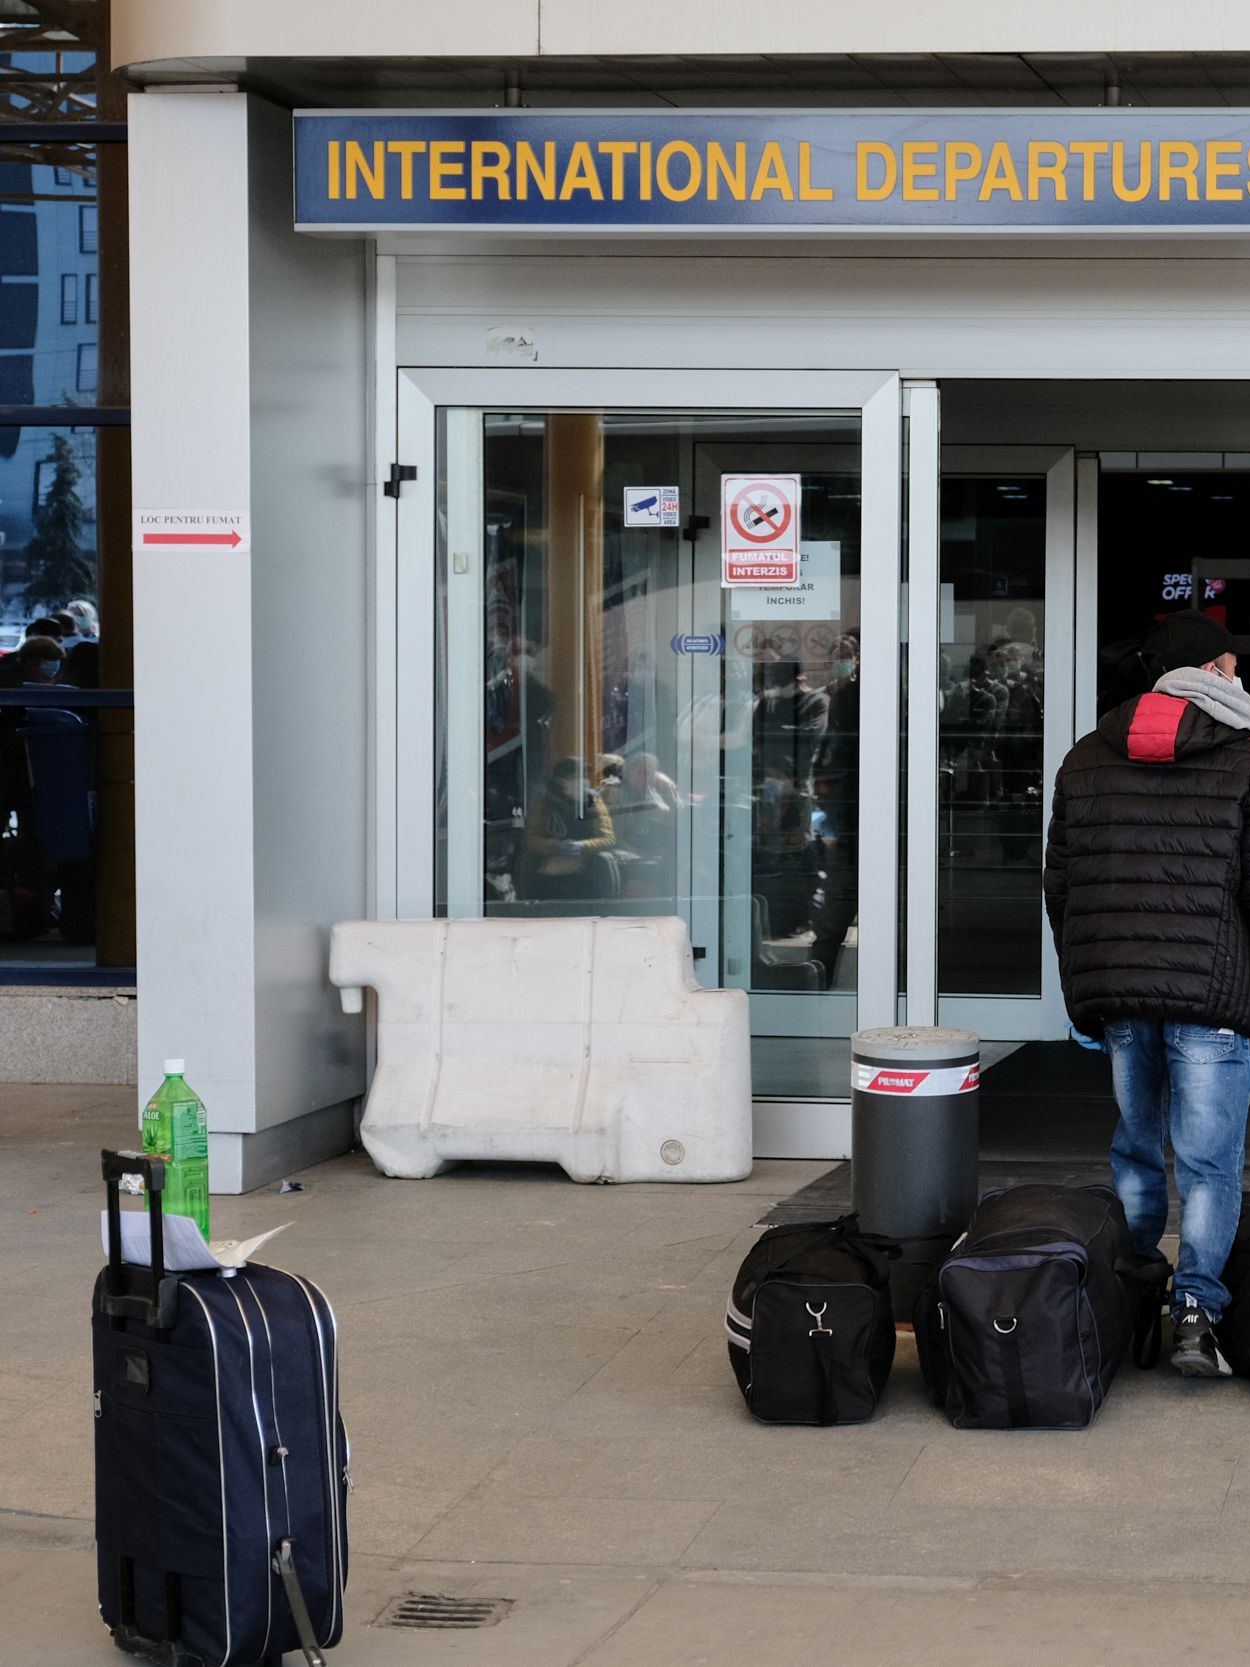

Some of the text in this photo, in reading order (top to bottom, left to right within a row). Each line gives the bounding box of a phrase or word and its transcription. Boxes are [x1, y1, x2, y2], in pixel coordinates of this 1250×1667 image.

[327, 140, 833, 202] INTERNATIONAL
[662, 502, 678, 512] 24H
[140, 515, 242, 524] LOC PENTRU FUMAT
[732, 552, 788, 562] FUMATUL
[733, 566, 788, 577] INTERZIS
[143, 1111, 160, 1121] ALOE
